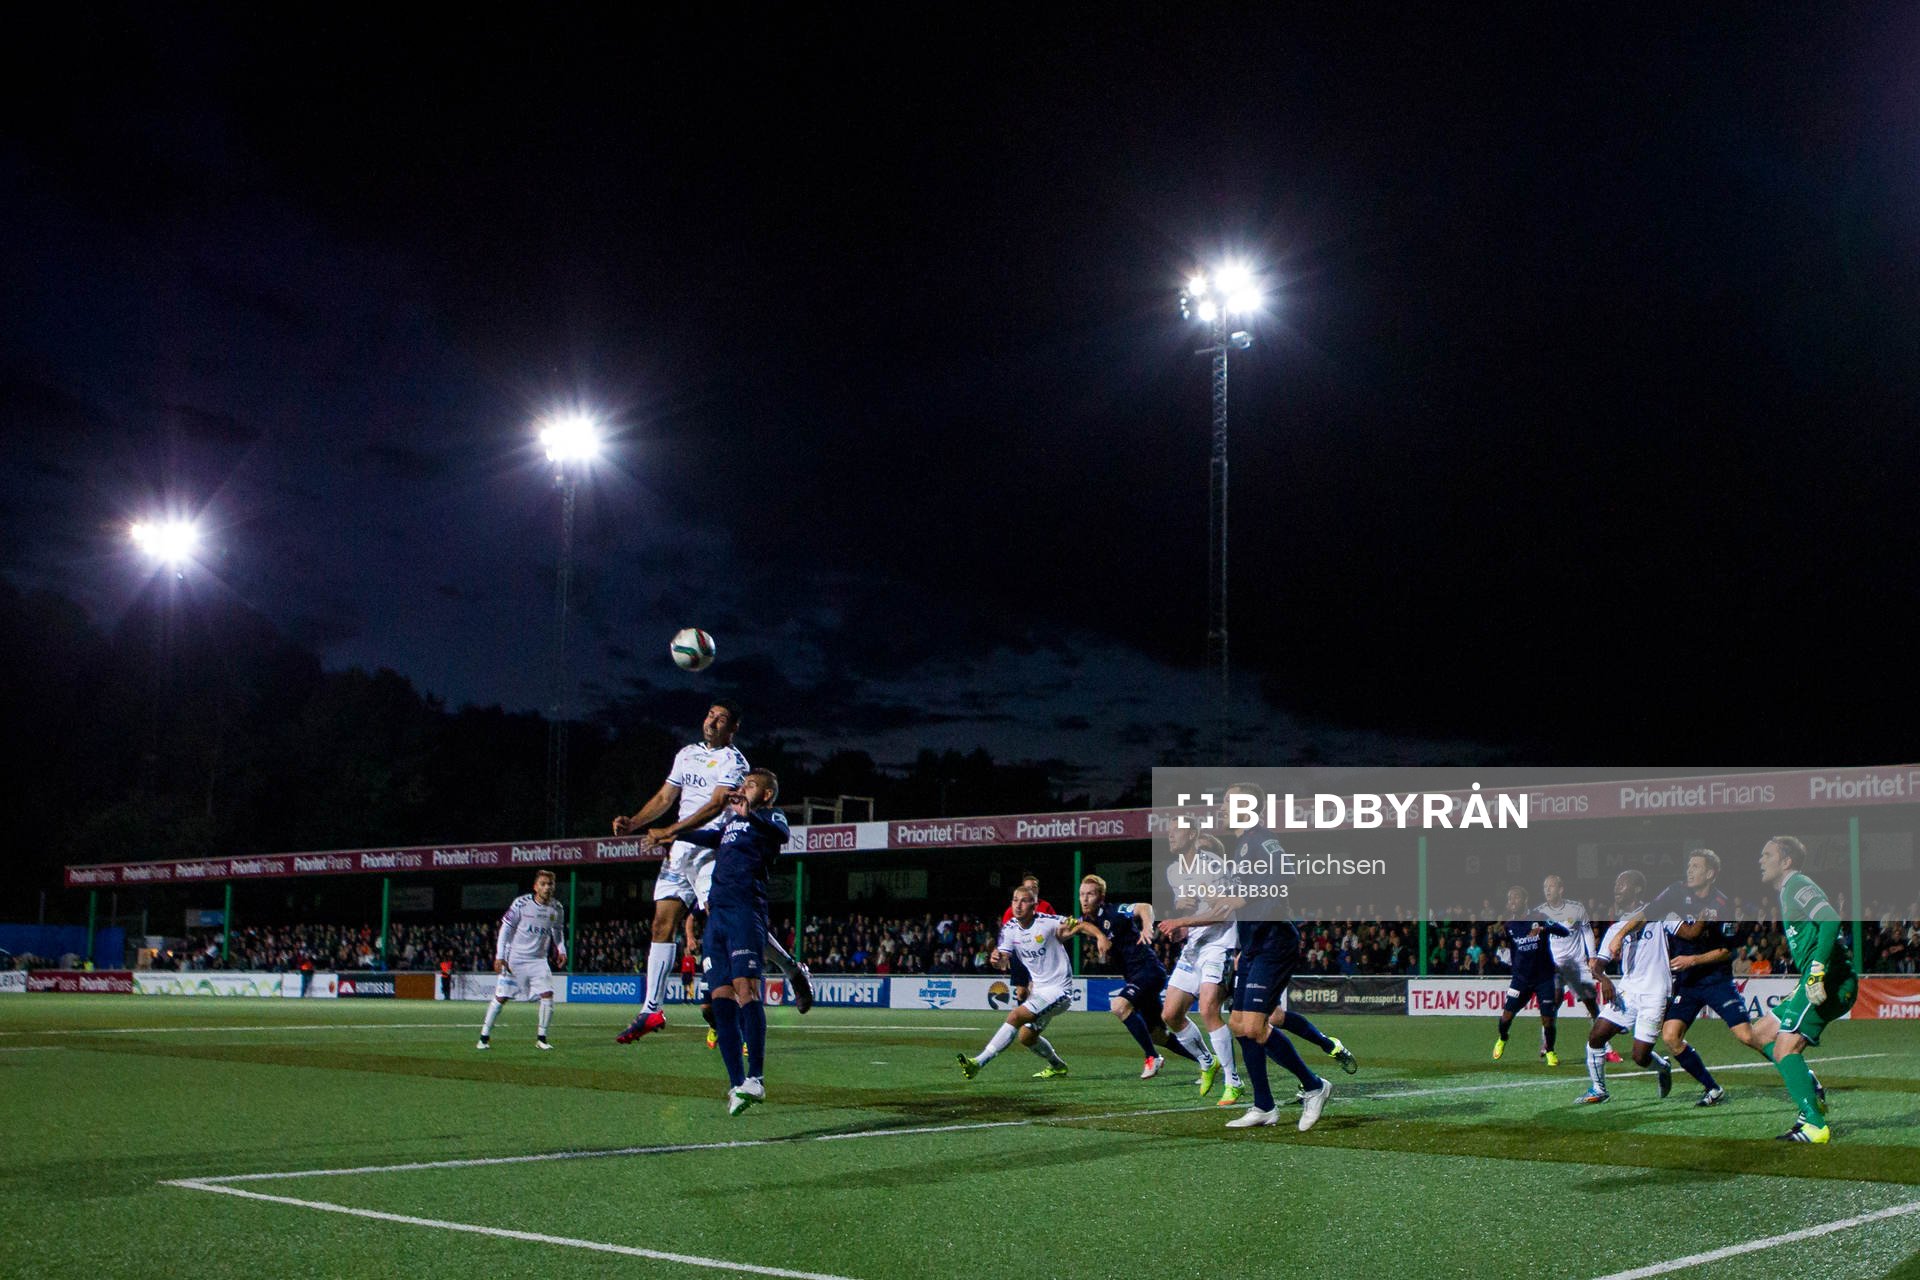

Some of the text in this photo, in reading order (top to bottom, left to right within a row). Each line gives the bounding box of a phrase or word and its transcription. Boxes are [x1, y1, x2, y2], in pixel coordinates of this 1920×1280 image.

[1620, 782, 1775, 809] Prioritet Finans
[1810, 774, 1904, 799] Prioritet
[1530, 791, 1589, 814] Finans
[898, 823, 996, 843] Prioritet Finans
[1017, 816, 1124, 839] Prioritet Finans
[809, 830, 854, 849] arena
[432, 850, 469, 866] Prioritet
[511, 844, 583, 863] Prioritet Finans
[597, 841, 639, 858] Prioritet
[571, 981, 636, 996] EHRENBORG
[1344, 994, 1406, 1006] www.erreasport.se
[1412, 990, 1460, 1010] TEAM
